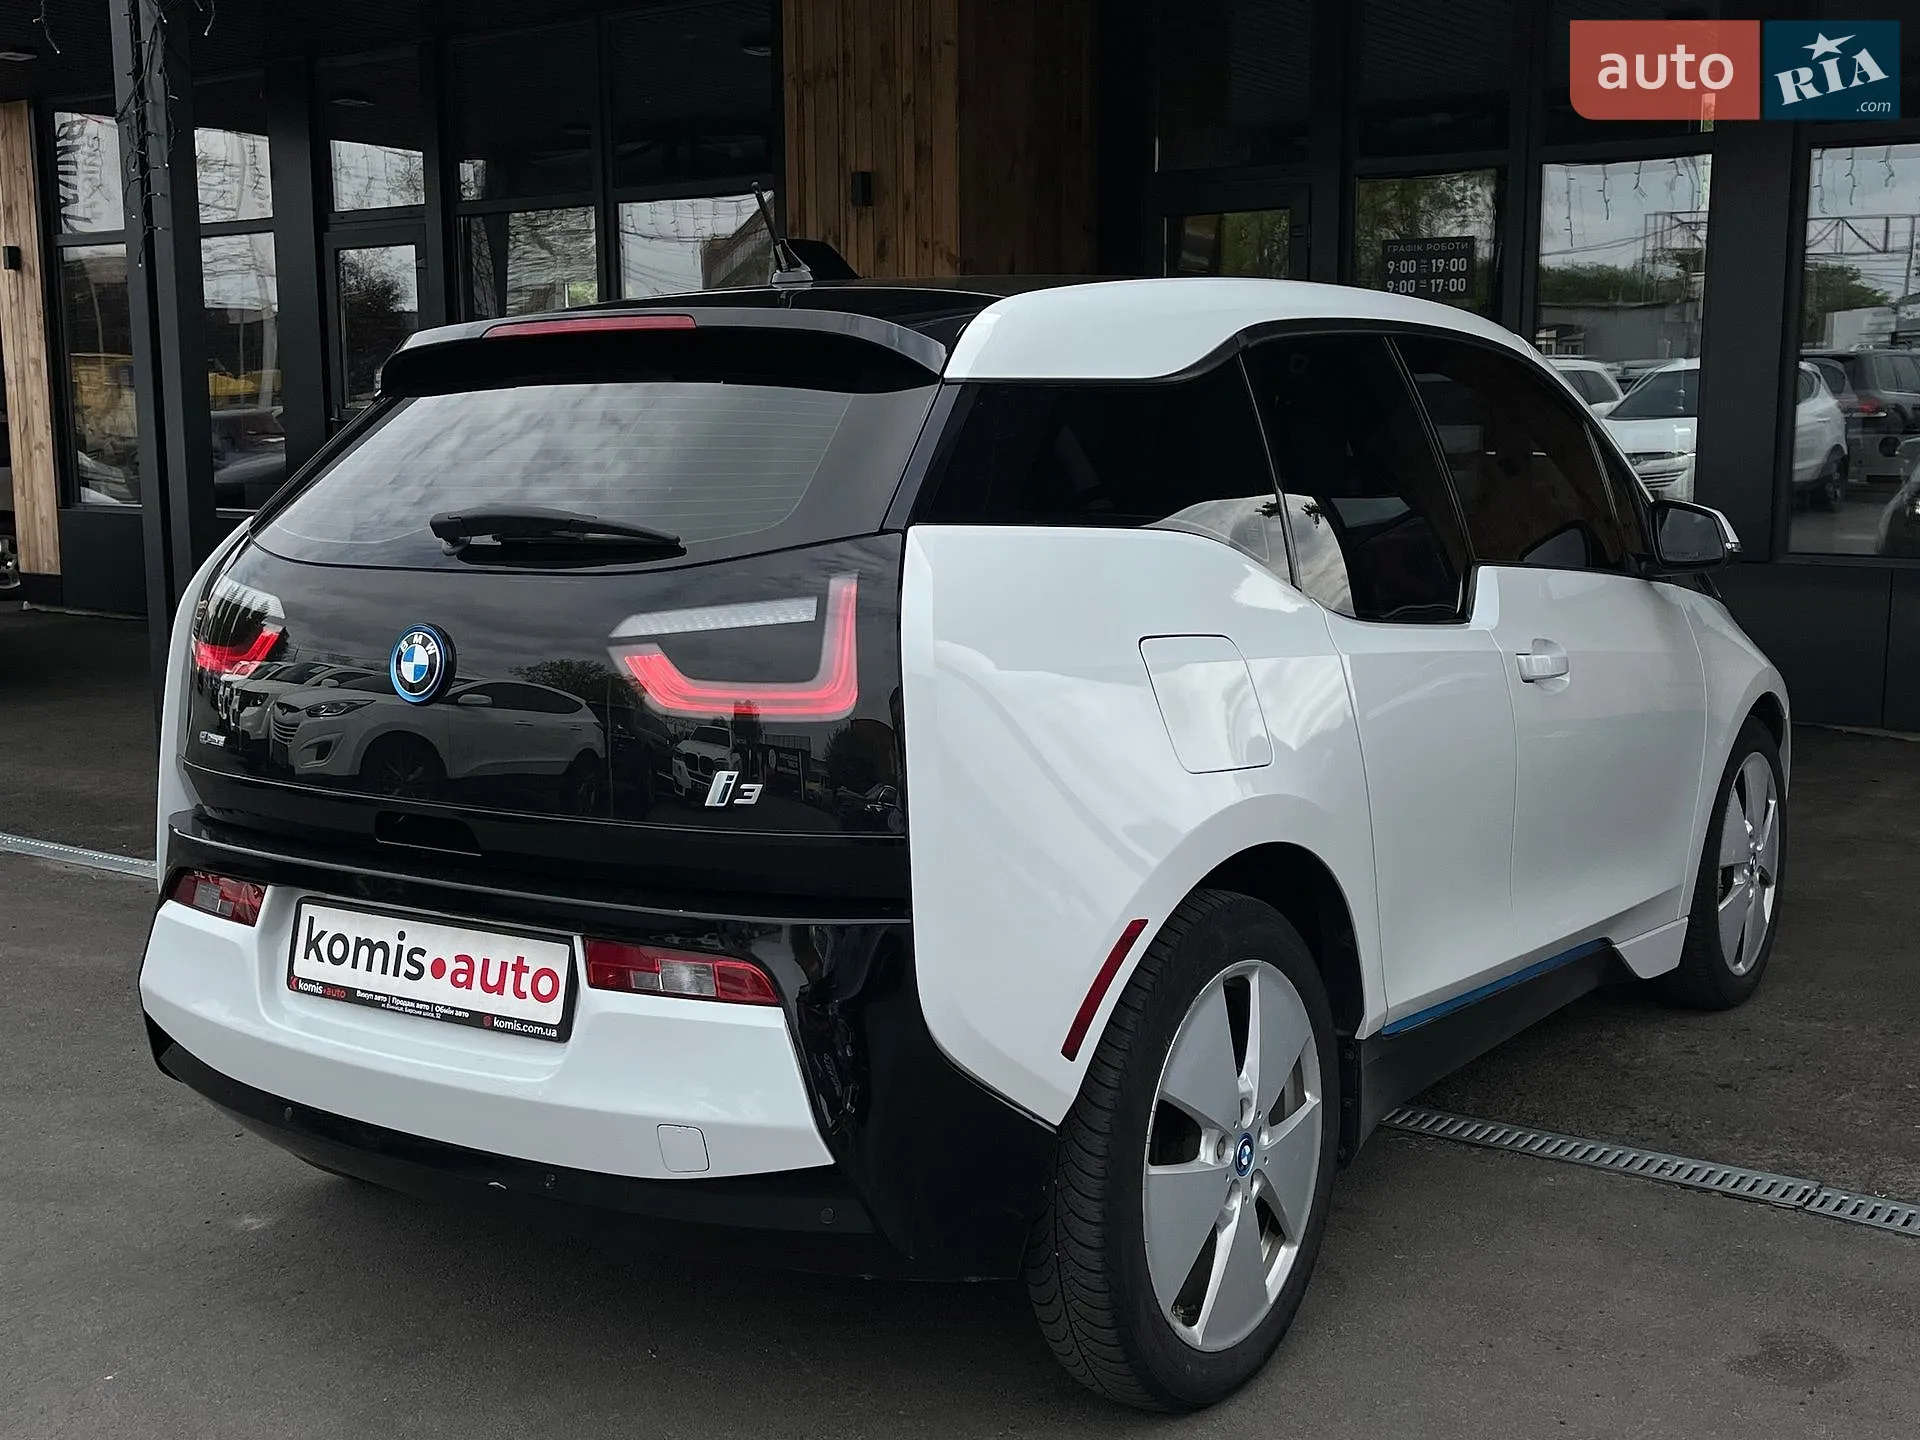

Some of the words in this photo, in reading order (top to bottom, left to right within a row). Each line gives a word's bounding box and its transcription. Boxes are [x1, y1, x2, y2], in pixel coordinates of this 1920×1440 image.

[1426, 241, 1468, 252] РОБОТИ
[1387, 259, 1417, 274] 9:00
[1431, 257, 1467, 273] 19:00
[1386, 279, 1416, 293] 9:00
[1430, 277, 1466, 293] 17:00
[704, 770, 764, 807] i3
[493, 1016, 558, 1037] komis.com.ua
